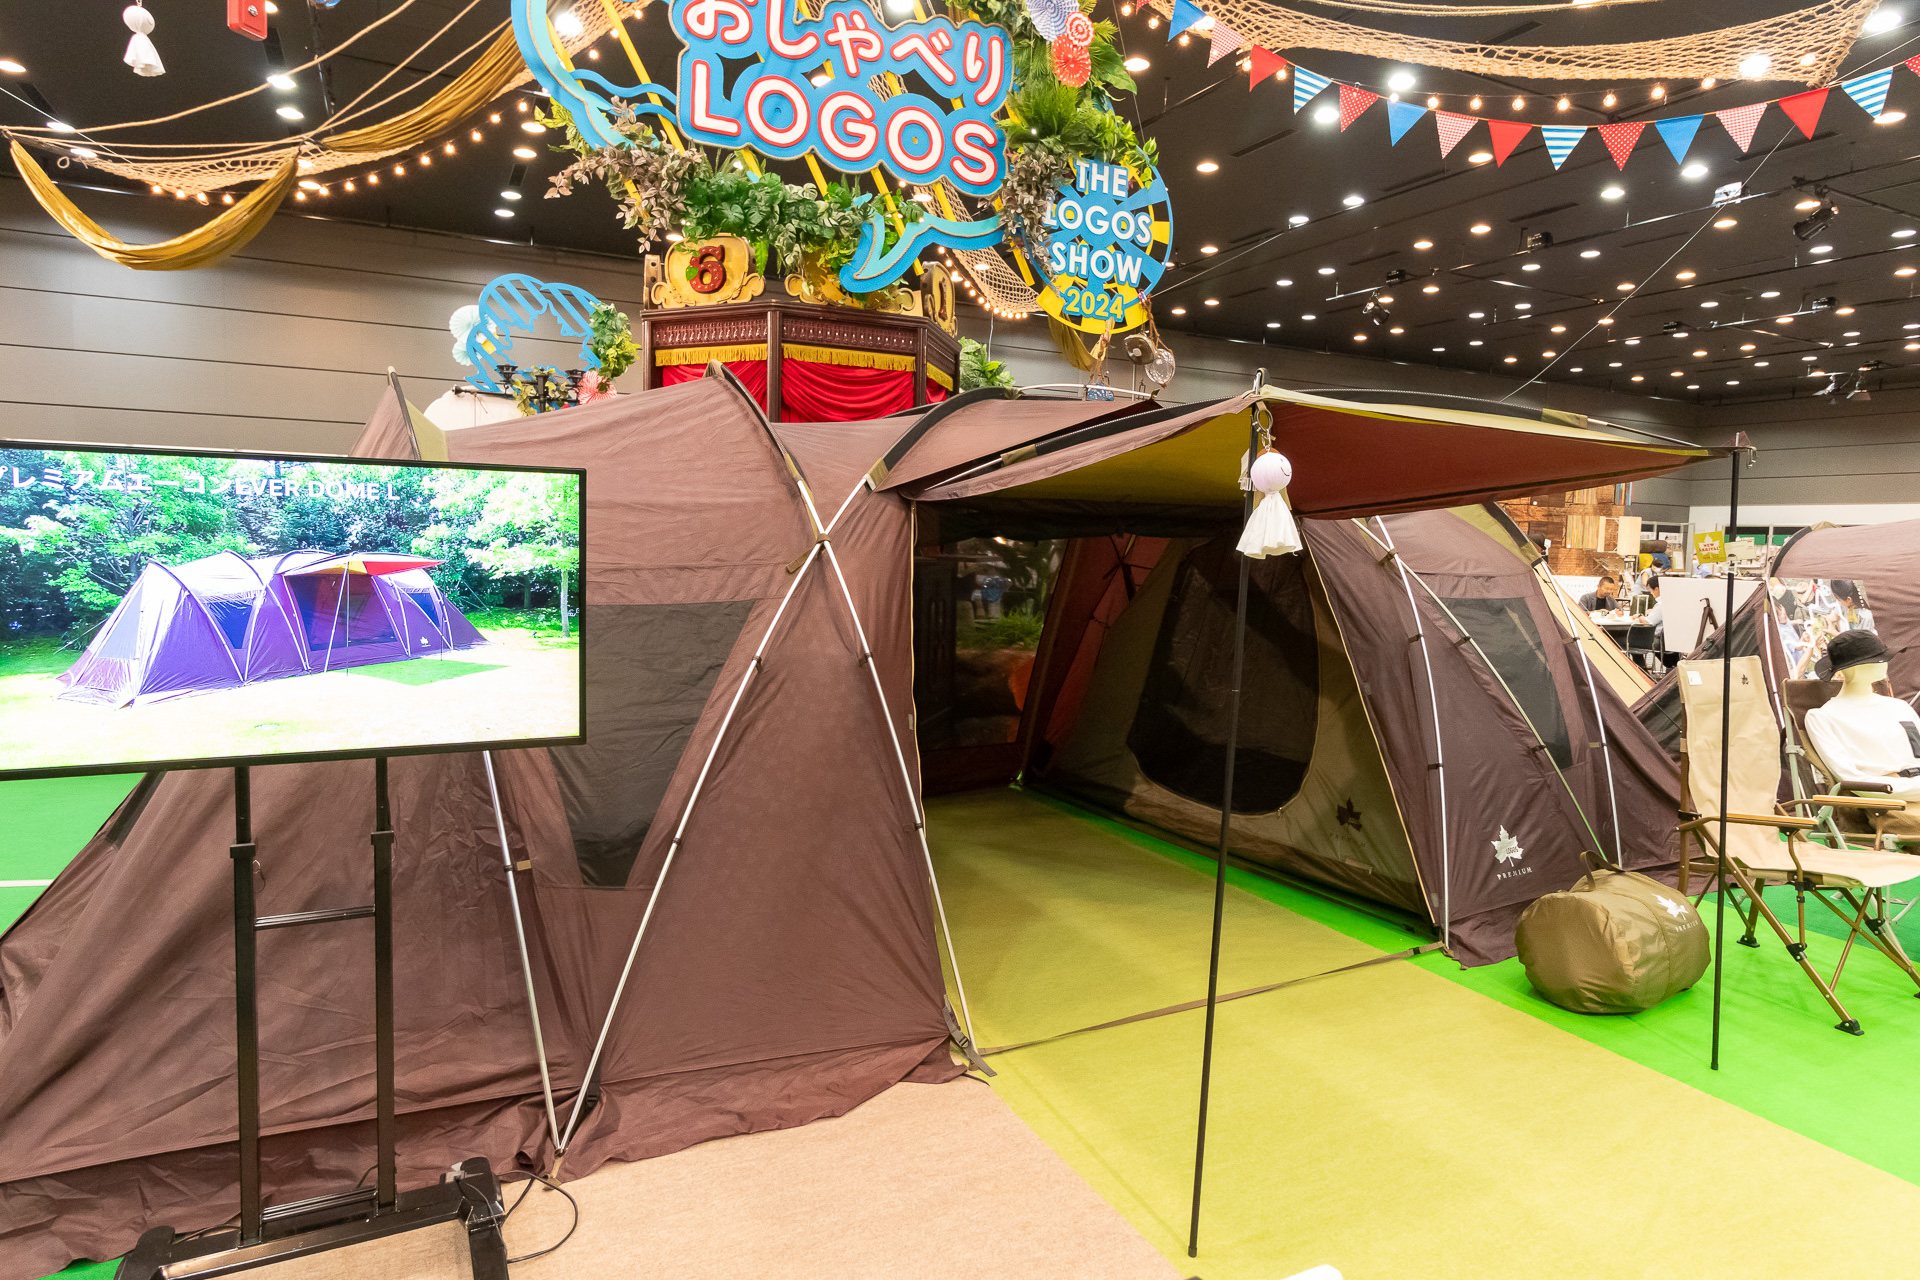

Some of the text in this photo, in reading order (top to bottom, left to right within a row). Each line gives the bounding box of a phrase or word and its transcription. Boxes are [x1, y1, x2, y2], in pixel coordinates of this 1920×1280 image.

[683, 0, 1005, 106] おしゃべり
[690, 59, 998, 185] LOGOS
[1076, 160, 1129, 198] THE
[1042, 199, 1151, 244] LOGOS
[690, 244, 726, 294] 6
[1051, 241, 1142, 284] SHOW
[1065, 291, 1123, 319] 2024
[308, 480, 380, 500] DOME
[387, 483, 400, 500] L
[1496, 867, 1532, 880] PREMIUM
